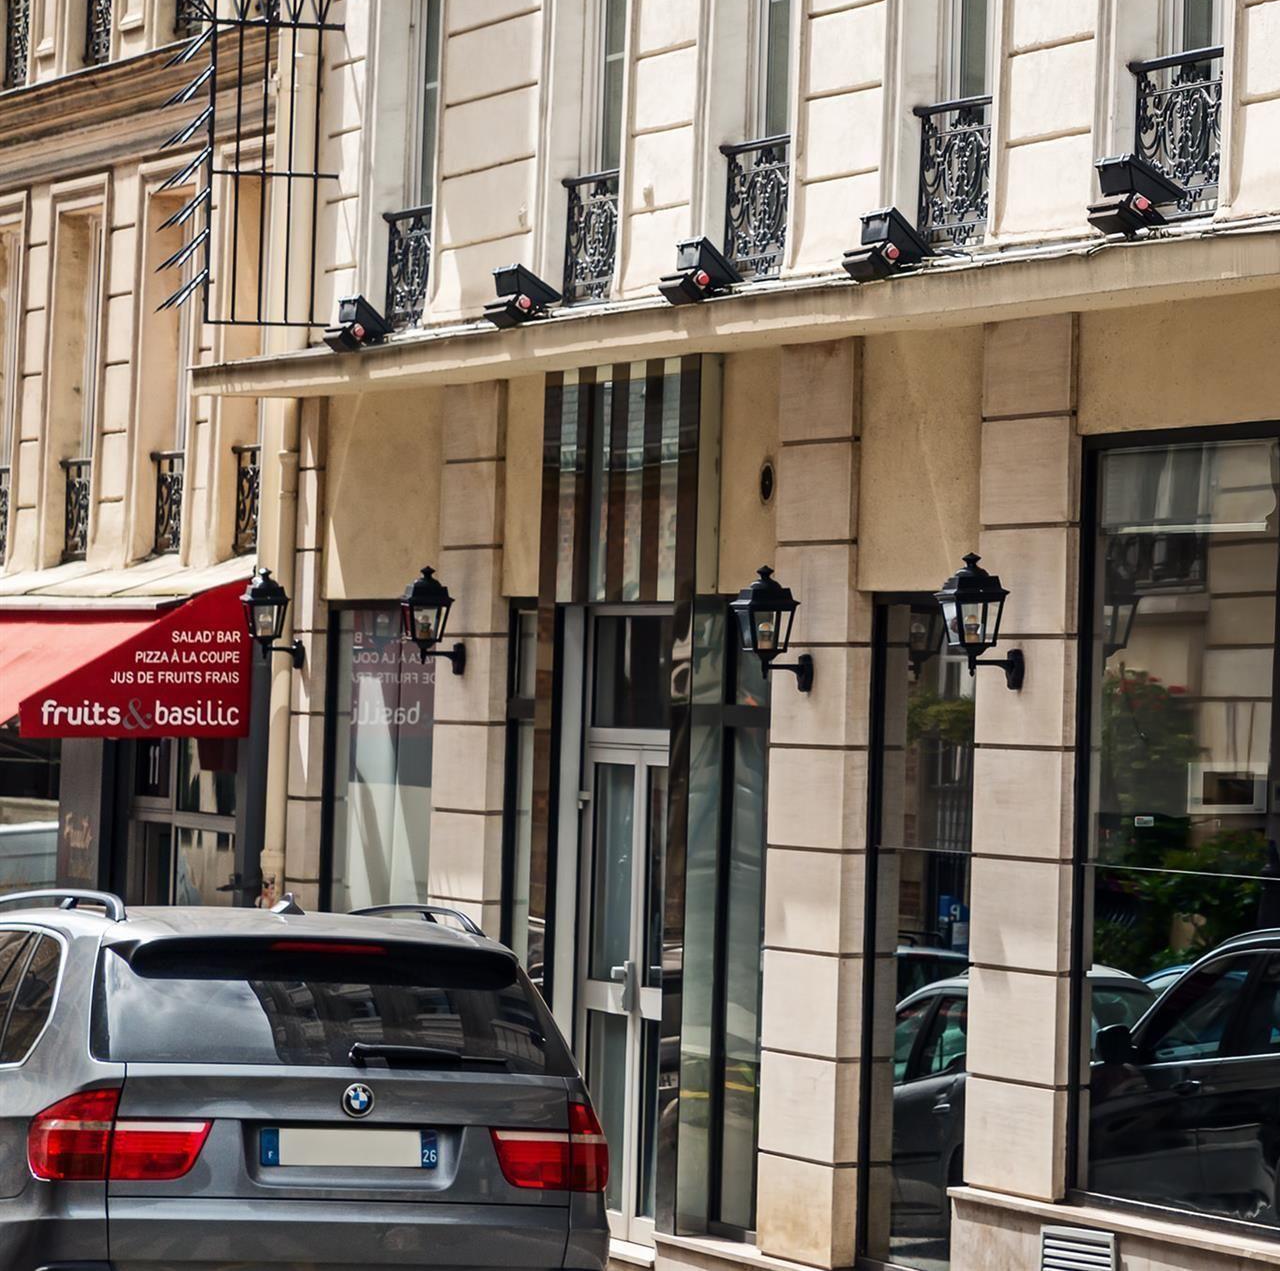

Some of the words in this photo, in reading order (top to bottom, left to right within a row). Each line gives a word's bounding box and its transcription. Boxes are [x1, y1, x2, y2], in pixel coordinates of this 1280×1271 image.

[217, 631, 241, 643] BAR
[135, 651, 169, 663] PIZZA
[171, 649, 180, 663] À
[182, 652, 198, 663] LA
[200, 651, 240, 663] COUPE
[111, 672, 134, 684] JUS
[137, 672, 154, 683] DE
[158, 672, 202, 684] FRUITS
[205, 672, 240, 684] FRAIS
[41, 699, 121, 725] fruits
[155, 699, 239, 726] basilic
[268, 1151, 274, 1159] F
[422, 1149, 437, 1163] 26
